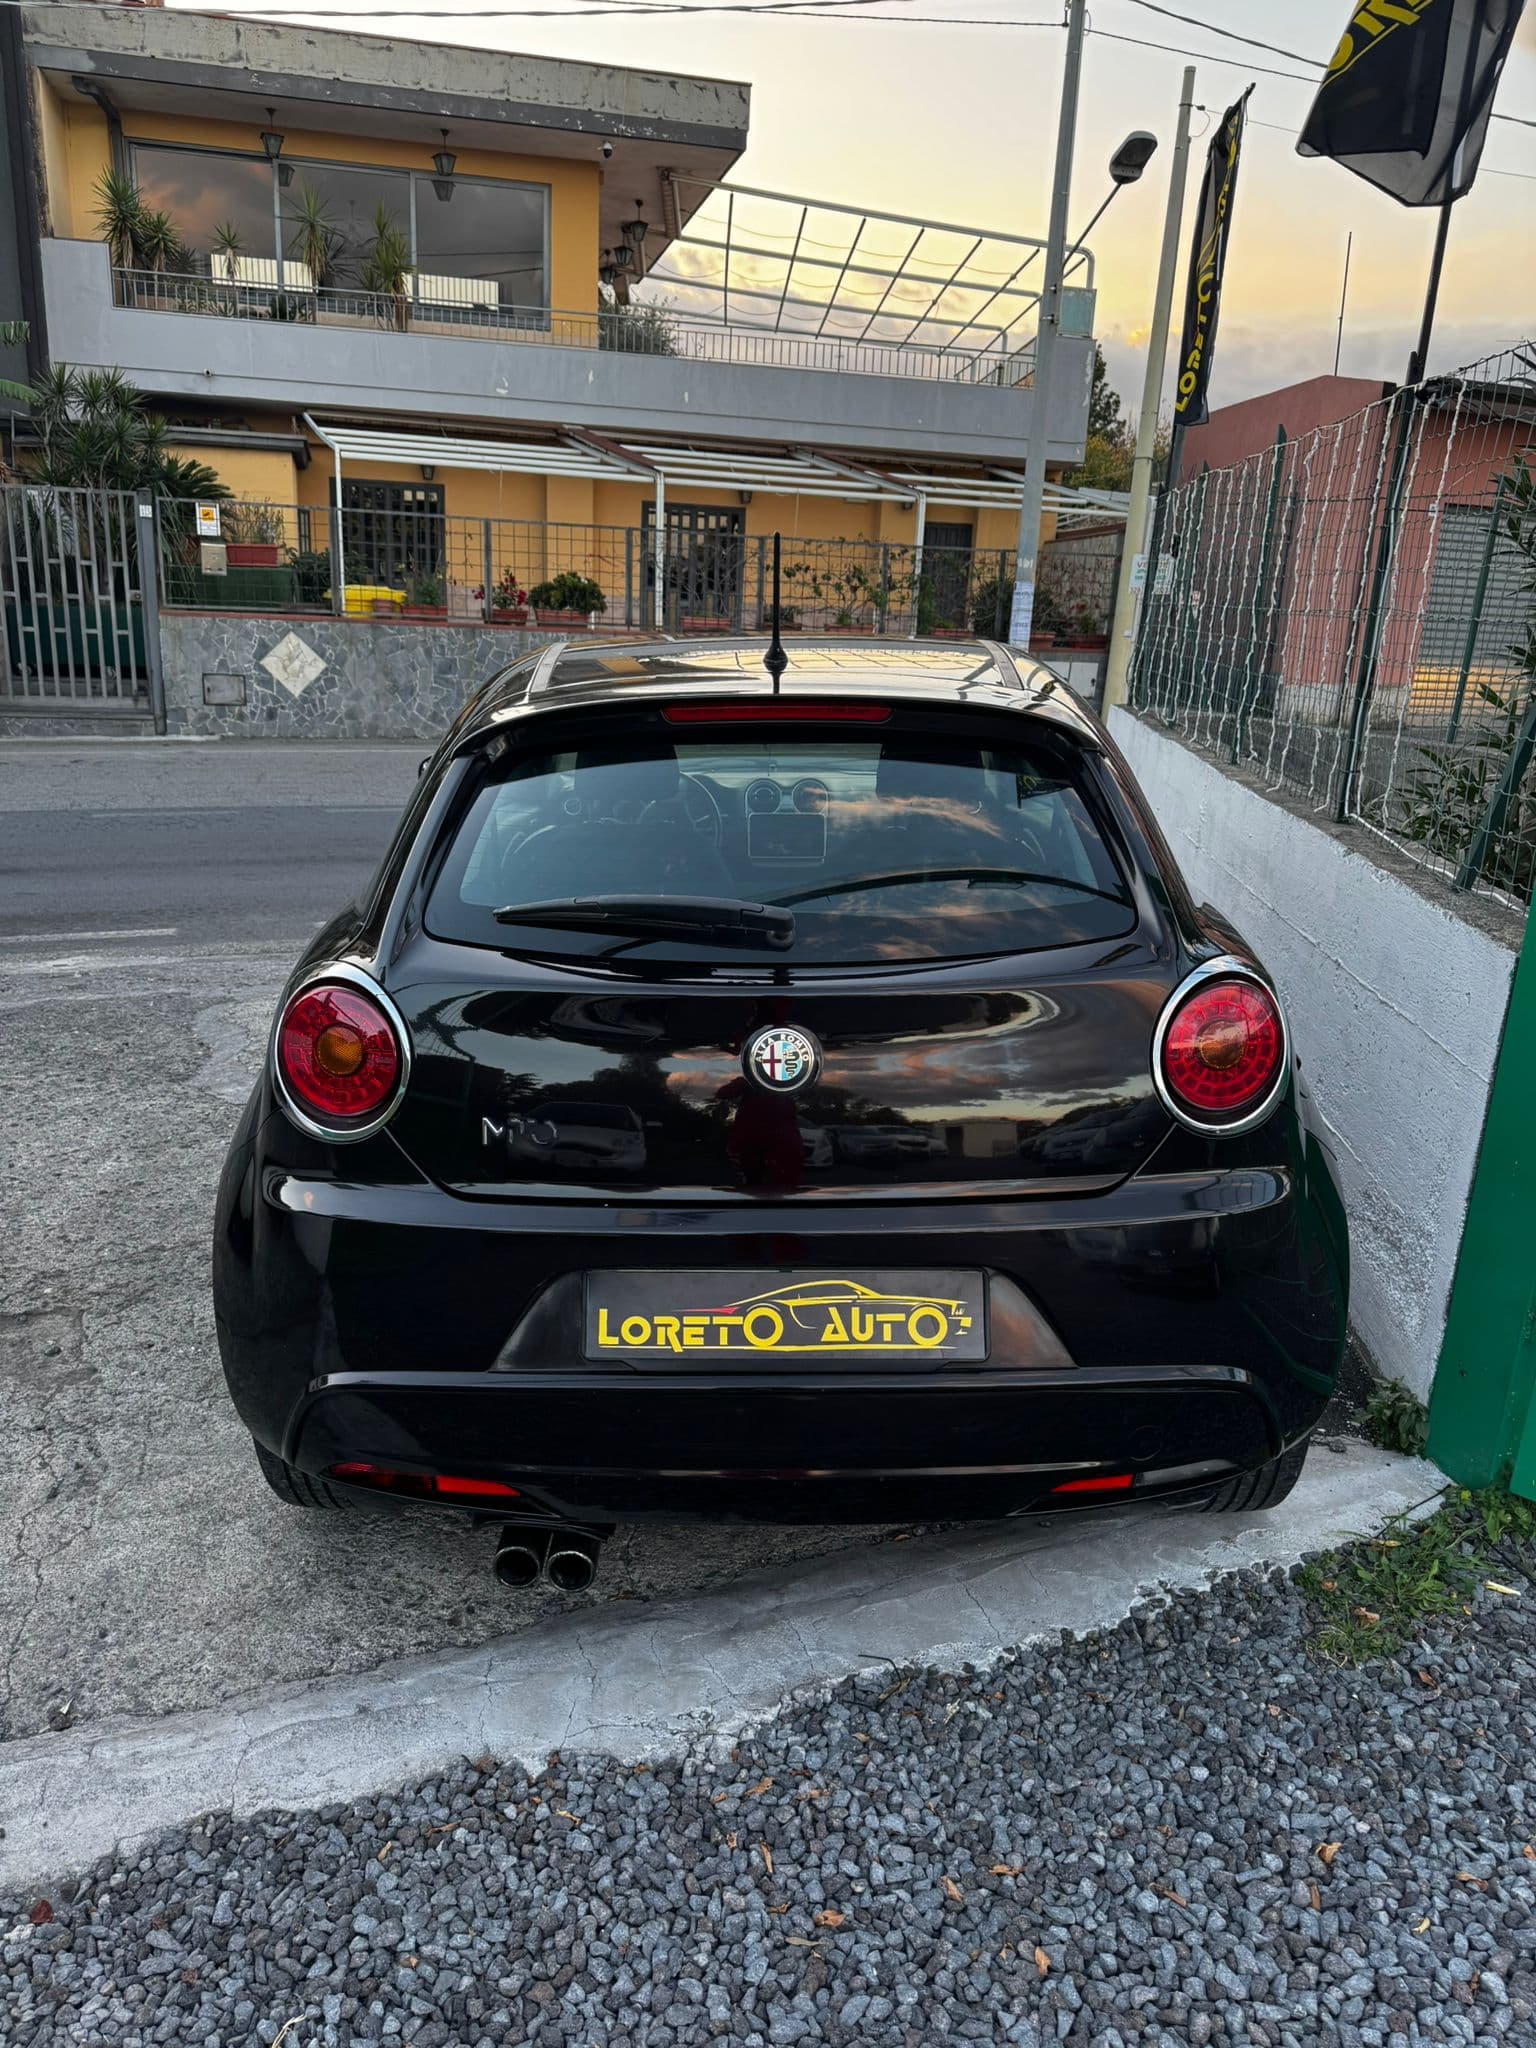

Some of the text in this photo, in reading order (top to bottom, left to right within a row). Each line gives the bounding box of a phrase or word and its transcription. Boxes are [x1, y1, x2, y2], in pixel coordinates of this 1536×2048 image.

[755, 1033, 810, 1063] ALFA ROMEO
[598, 1306, 948, 1353] LORETO AUTO
